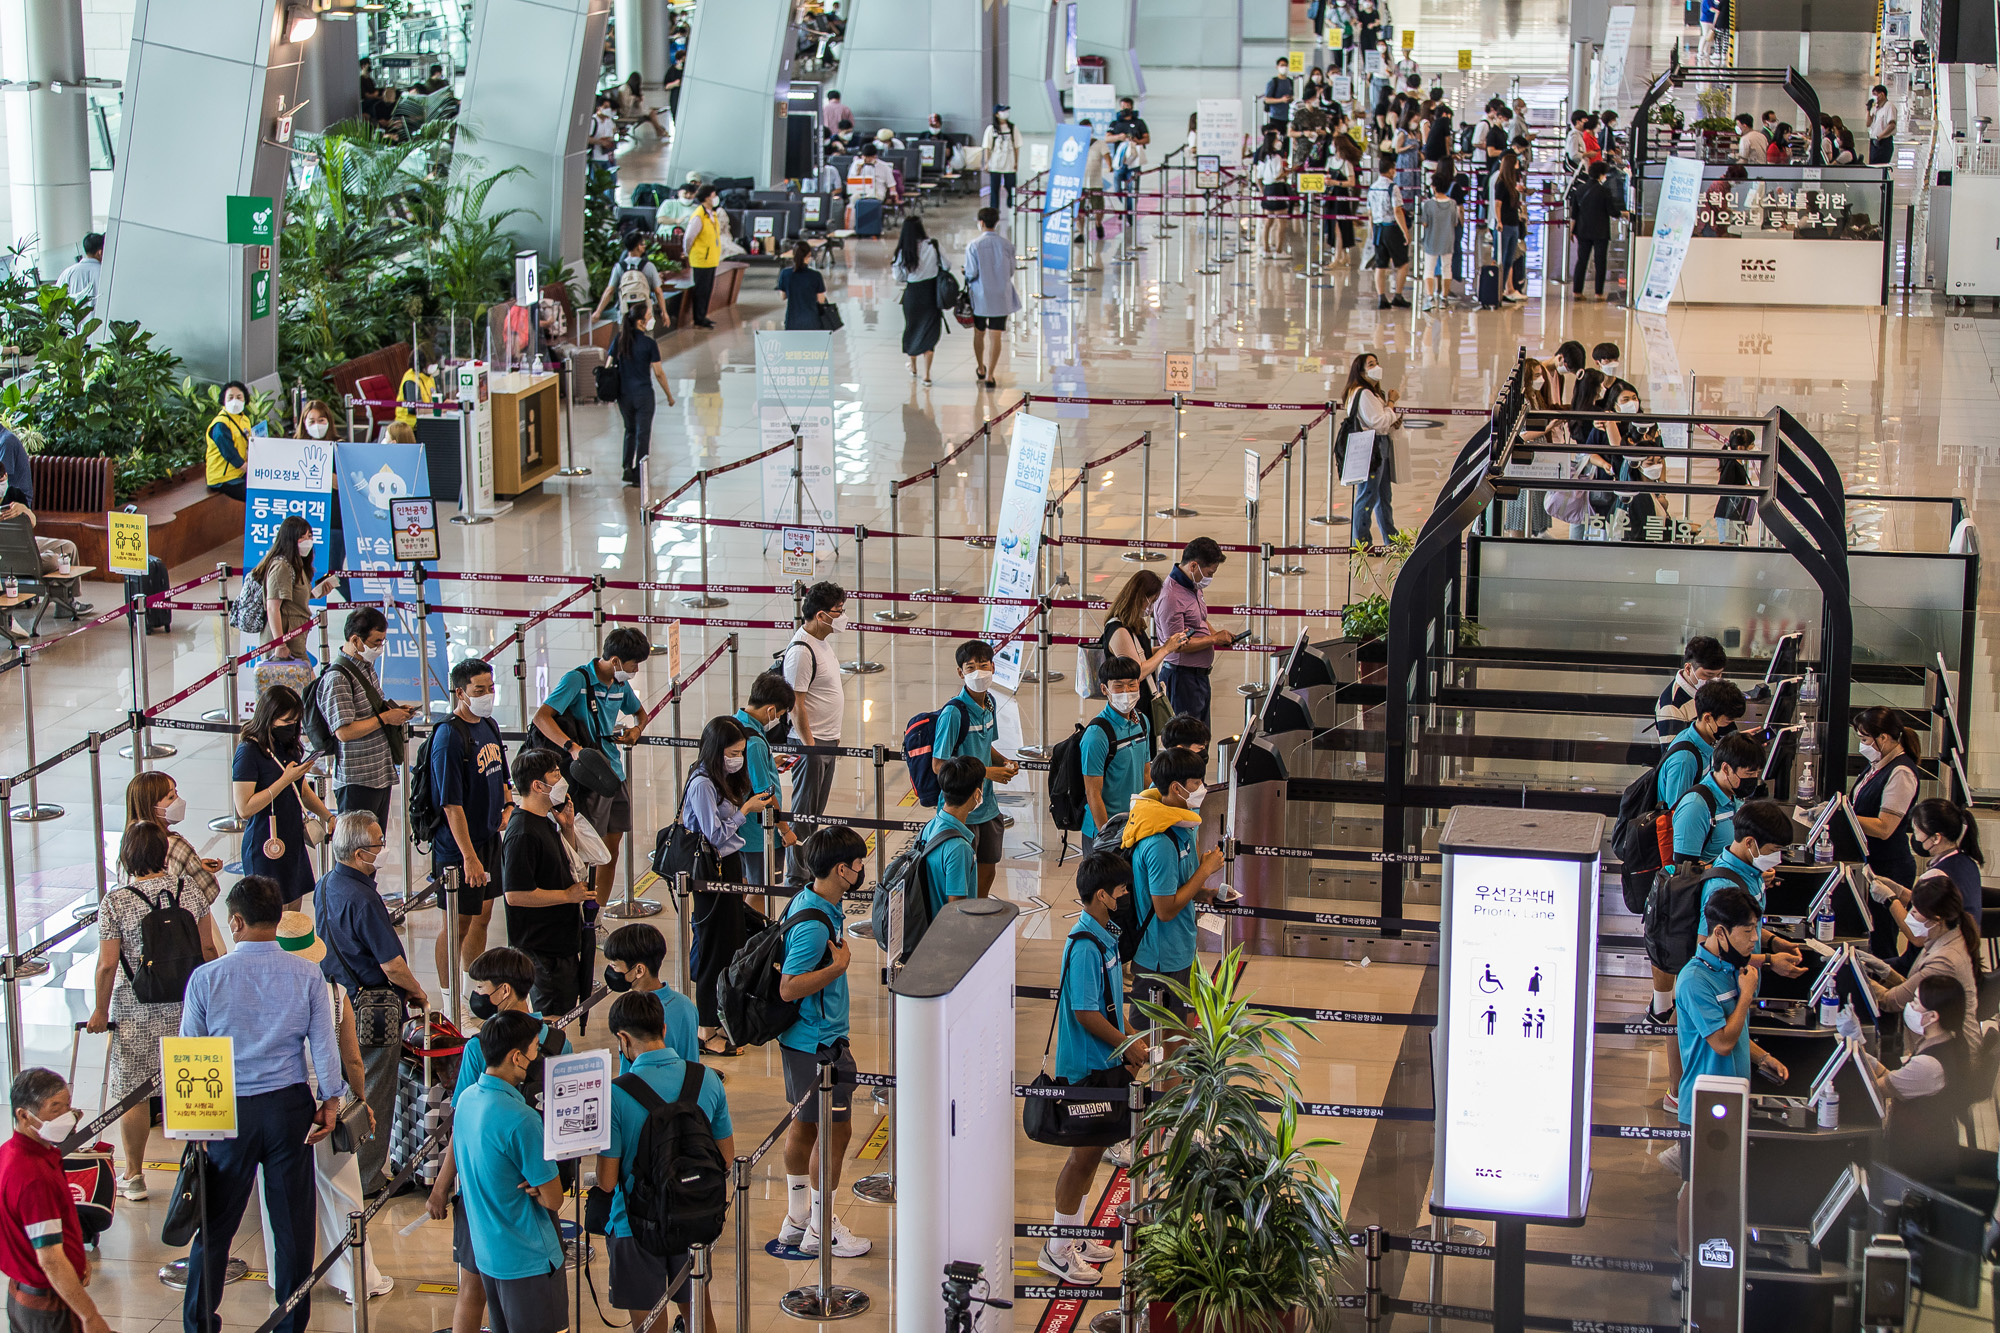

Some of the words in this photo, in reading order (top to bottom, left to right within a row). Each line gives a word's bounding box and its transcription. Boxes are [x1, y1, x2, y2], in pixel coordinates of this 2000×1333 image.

[1815, 192, 1847, 210] 위한
[1696, 211, 1762, 227] 이오정보
[1769, 212, 1799, 228] 등록
[1807, 212, 1838, 228] 부스
[1741, 259, 1776, 271] KAC
[1020, 447, 1047, 465] 손하나로
[255, 468, 300, 481] 바이오정보
[309, 464, 319, 476] 손
[1017, 462, 1044, 483] 탑승하자
[252, 497, 325, 521] 등록여객
[397, 505, 428, 516] 인천공항
[775, 586, 792, 594] KAC
[1233, 607, 1251, 615] KAC
[1305, 608, 1323, 616] KAC
[156, 719, 175, 728] KAC
[649, 737, 668, 745] KAC
[846, 748, 867, 757] KAC
[794, 814, 815, 823] KAC
[1255, 846, 1278, 855] KAC
[1372, 853, 1395, 862] KAC
[707, 882, 730, 892] KAC
[1475, 885, 1555, 905] 우선검색대
[1316, 914, 1340, 924] KAC
[1316, 1010, 1342, 1021] KAC
[1344, 1013, 1383, 1022] 한국공항공사
[1625, 1024, 1652, 1034] KAC
[173, 1054, 190, 1063] 함께
[194, 1055, 223, 1063] 지켜요!
[579, 1079, 602, 1091] 신분증
[856, 1074, 883, 1086] KAC
[1025, 1087, 1065, 1097] 한국공항공사
[556, 1106, 580, 1117] 탑승권
[1068, 1103, 1096, 1116] POLAR
[1096, 1102, 1112, 1113] GYM
[1312, 1104, 1340, 1116] KAC
[1342, 1107, 1384, 1117] 한국공항공사
[1620, 1127, 1649, 1138] KAC
[1476, 1167, 1502, 1179] KAC
[1027, 1226, 1058, 1236] KAC
[1060, 1228, 1105, 1237] 한국공항공사
[1411, 1239, 1442, 1253] KAC
[1572, 1255, 1603, 1268] KAC
[1706, 1253, 1728, 1263] PASS
[1025, 1287, 1056, 1298] KAC
[1058, 1289, 1103, 1298] 한국공항공사
[1412, 1302, 1443, 1316] KAC
[1573, 1321, 1604, 1333] KAC
